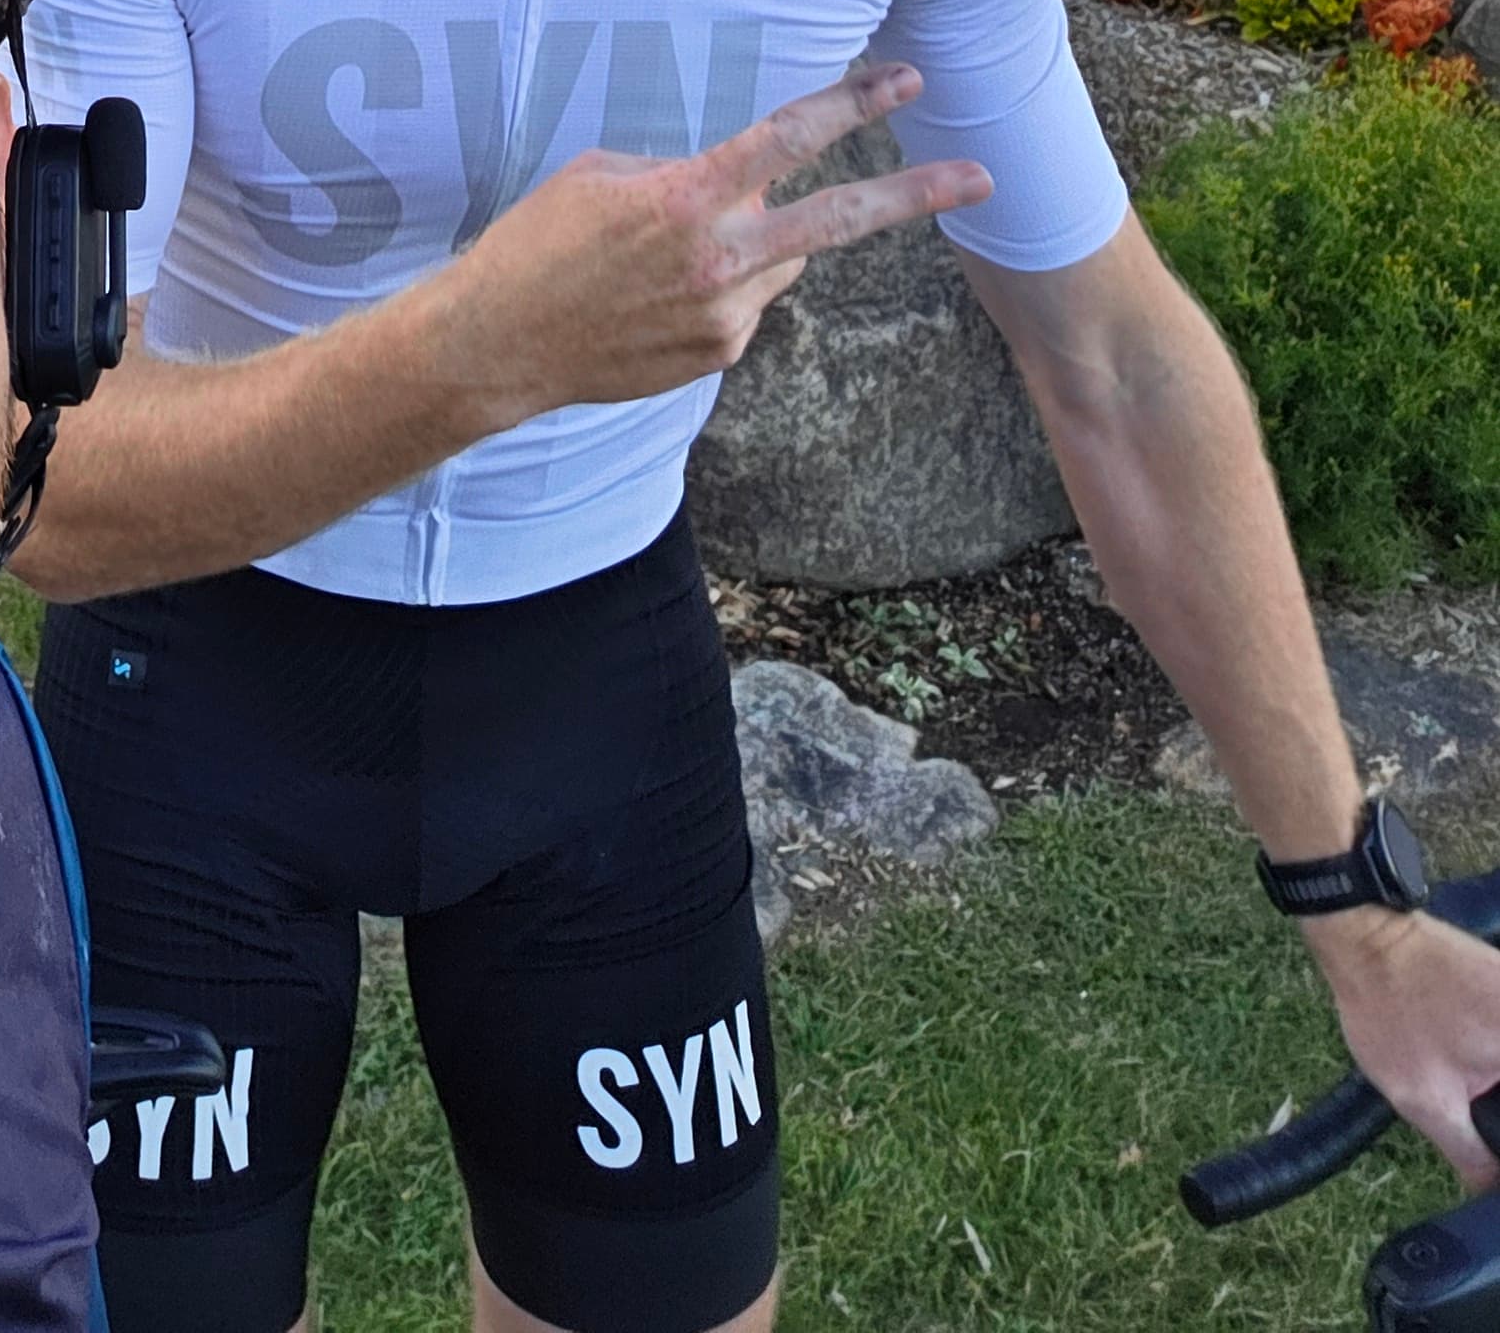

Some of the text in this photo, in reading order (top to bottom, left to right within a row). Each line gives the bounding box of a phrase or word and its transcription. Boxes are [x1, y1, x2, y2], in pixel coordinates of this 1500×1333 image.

[235, 17, 764, 267] SYN
[86, 1048, 254, 1181] YN
[577, 999, 762, 1170] SYN
